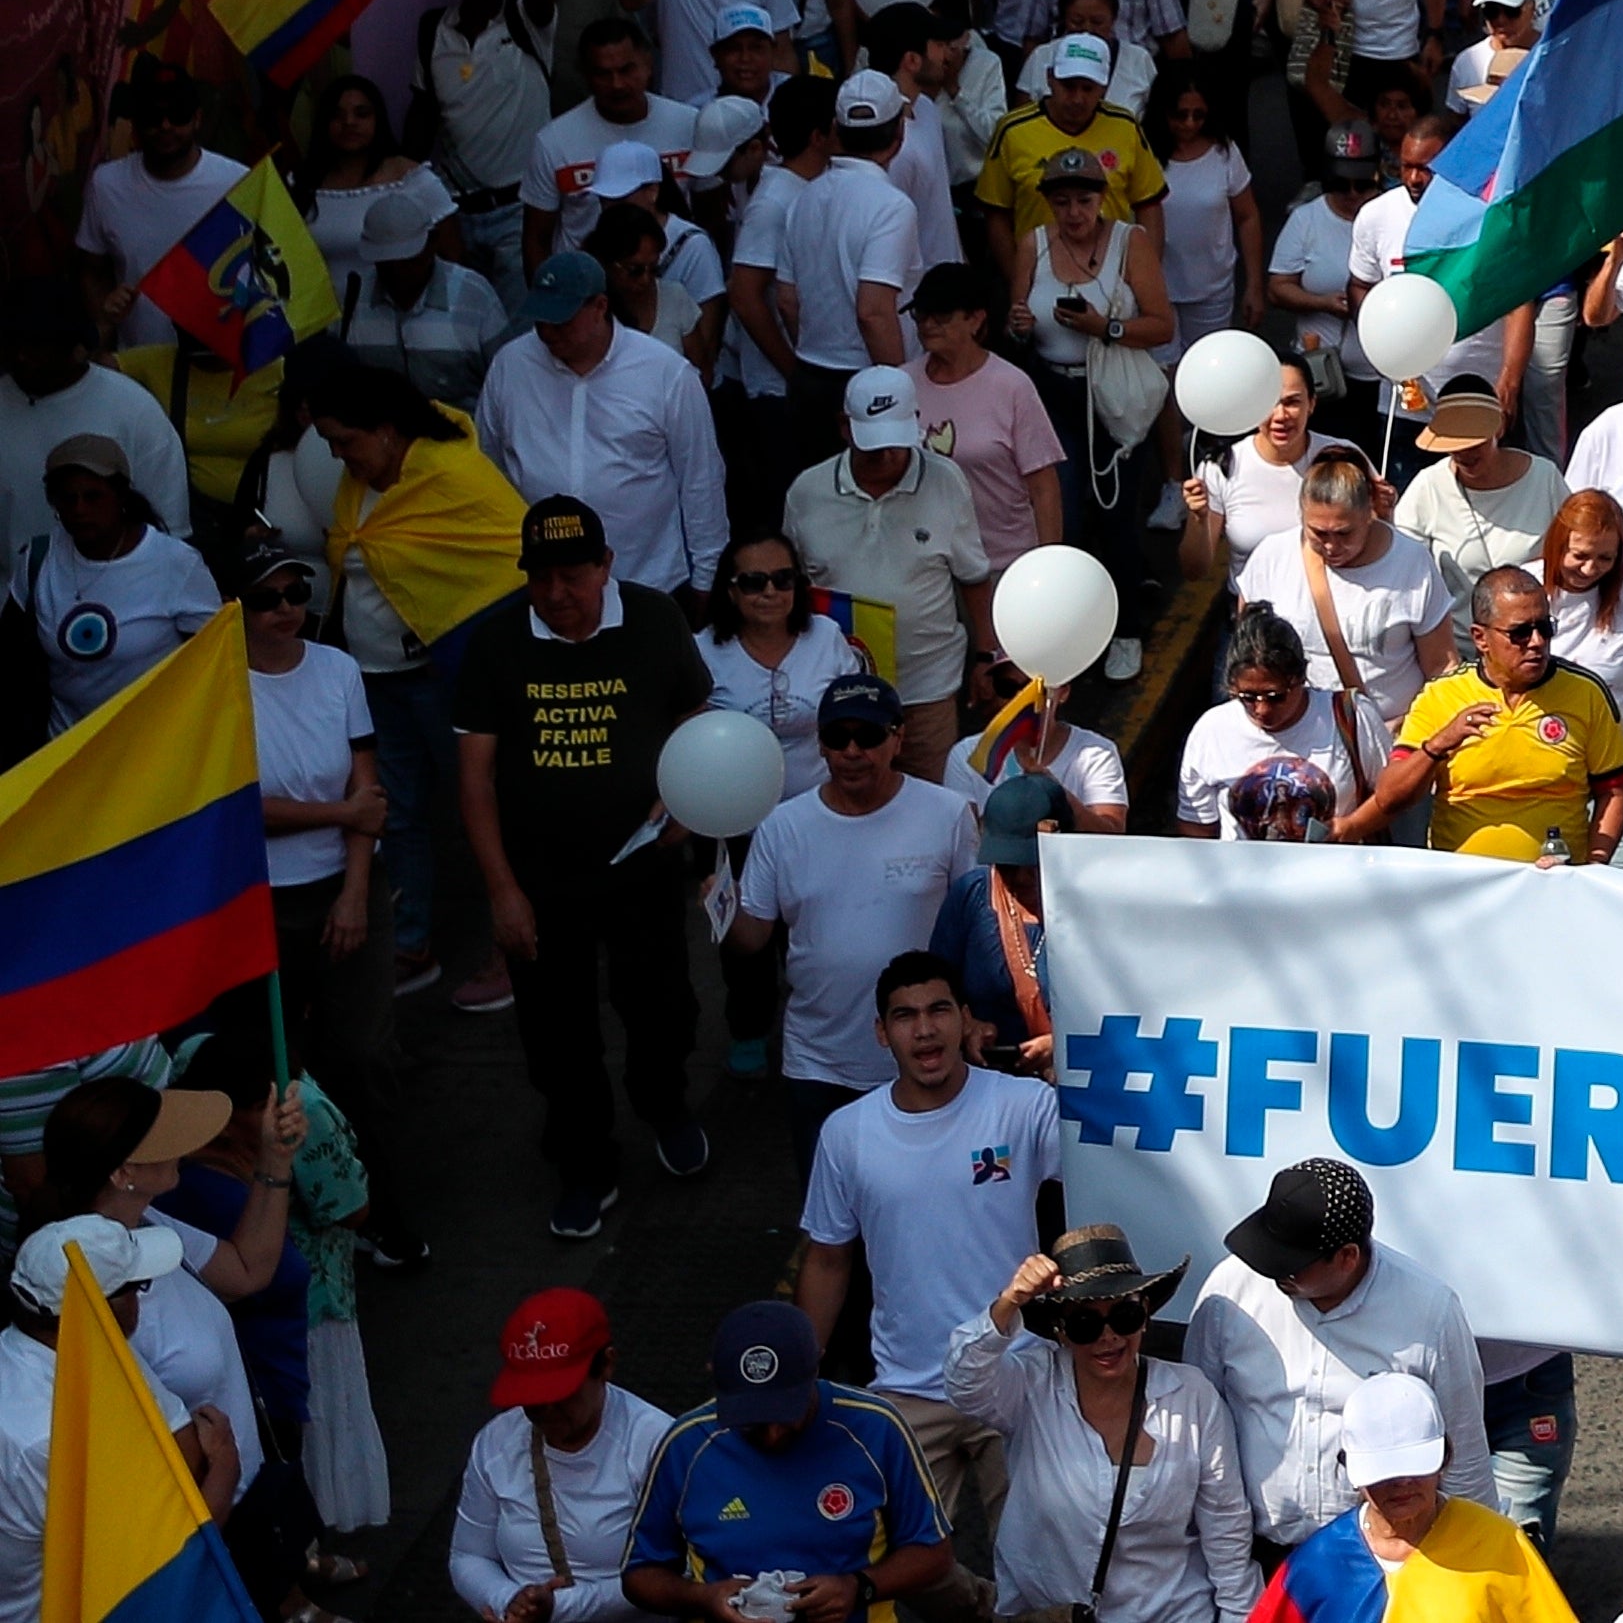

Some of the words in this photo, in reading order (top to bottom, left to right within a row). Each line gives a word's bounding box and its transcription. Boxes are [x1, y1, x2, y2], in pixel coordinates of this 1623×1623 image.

[526, 677, 629, 700] RESERVA
[532, 704, 618, 726] ACTIVA
[539, 727, 610, 747] FF.MM
[532, 748, 613, 769] VALLE
